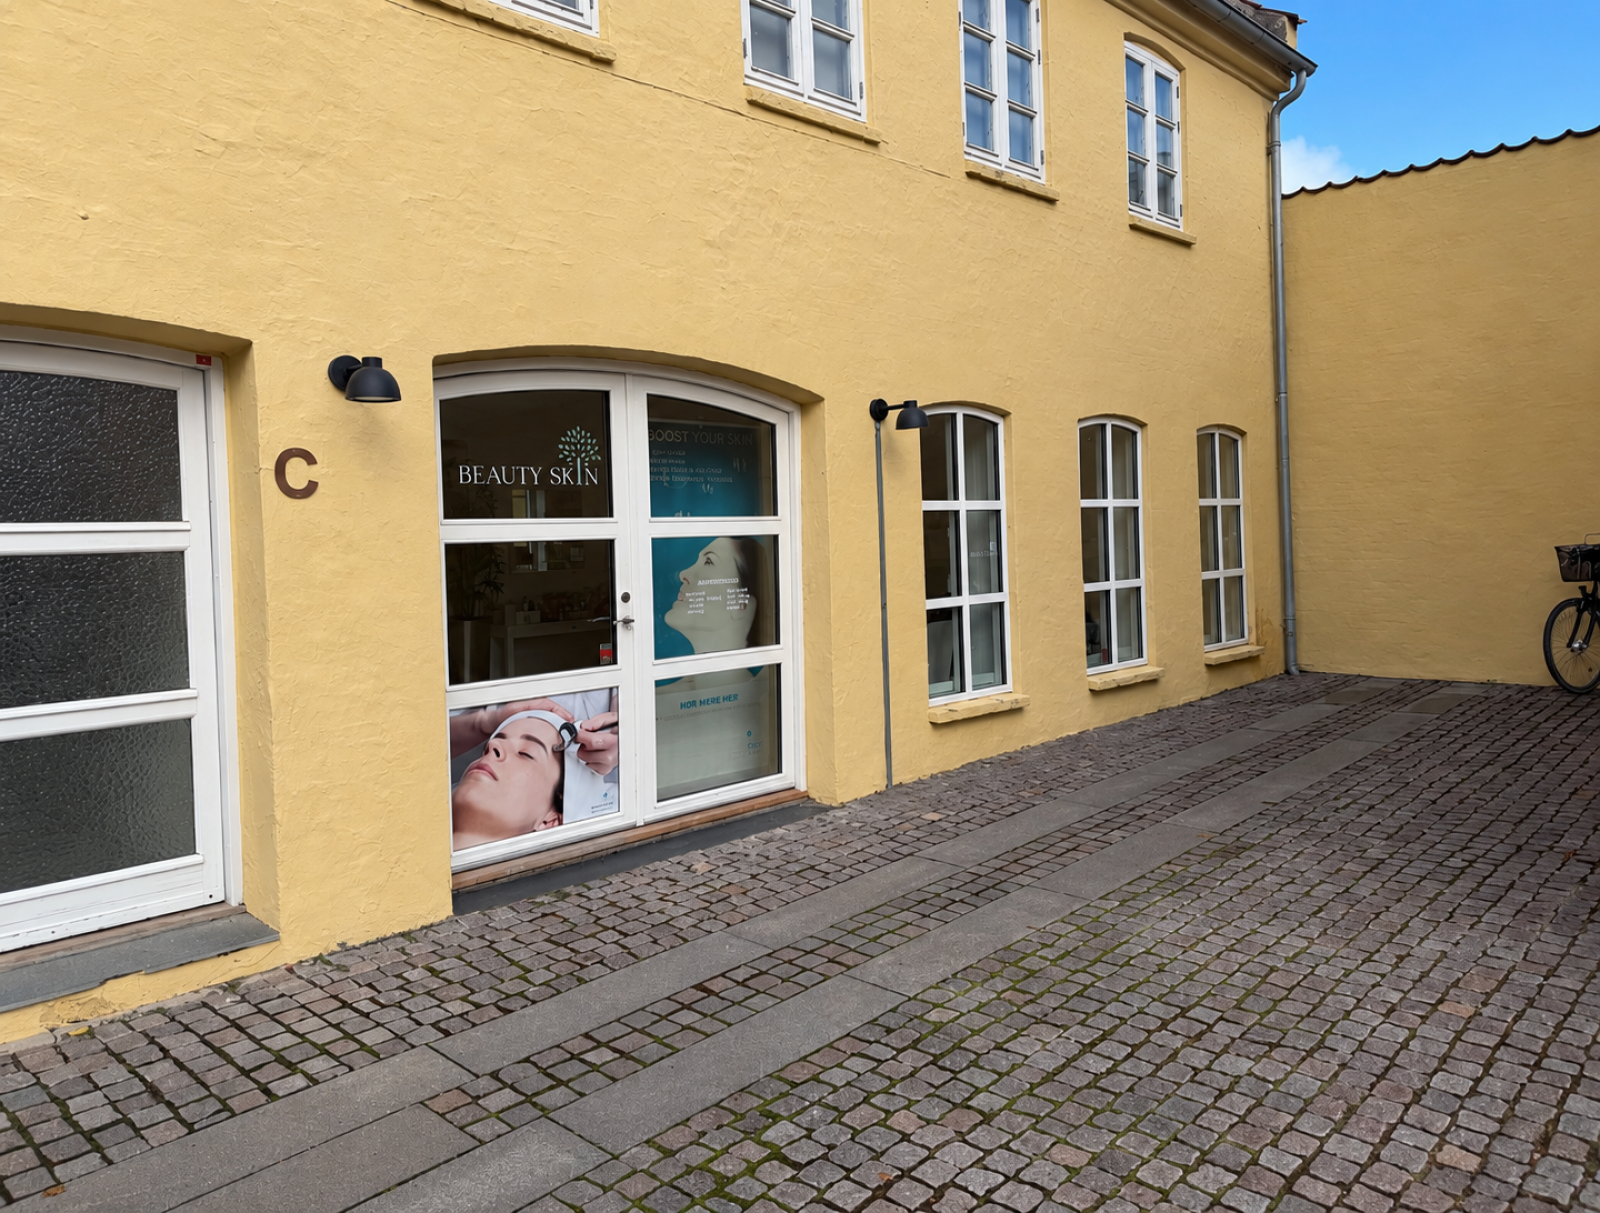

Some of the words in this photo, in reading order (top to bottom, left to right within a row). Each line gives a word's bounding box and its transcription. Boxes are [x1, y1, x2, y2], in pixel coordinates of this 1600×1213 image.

[691, 431, 725, 445] YOUR
[728, 433, 753, 446] SKIN
[274, 447, 319, 500] C
[459, 465, 542, 486] BEAUTY
[550, 458, 598, 486] SKIN
